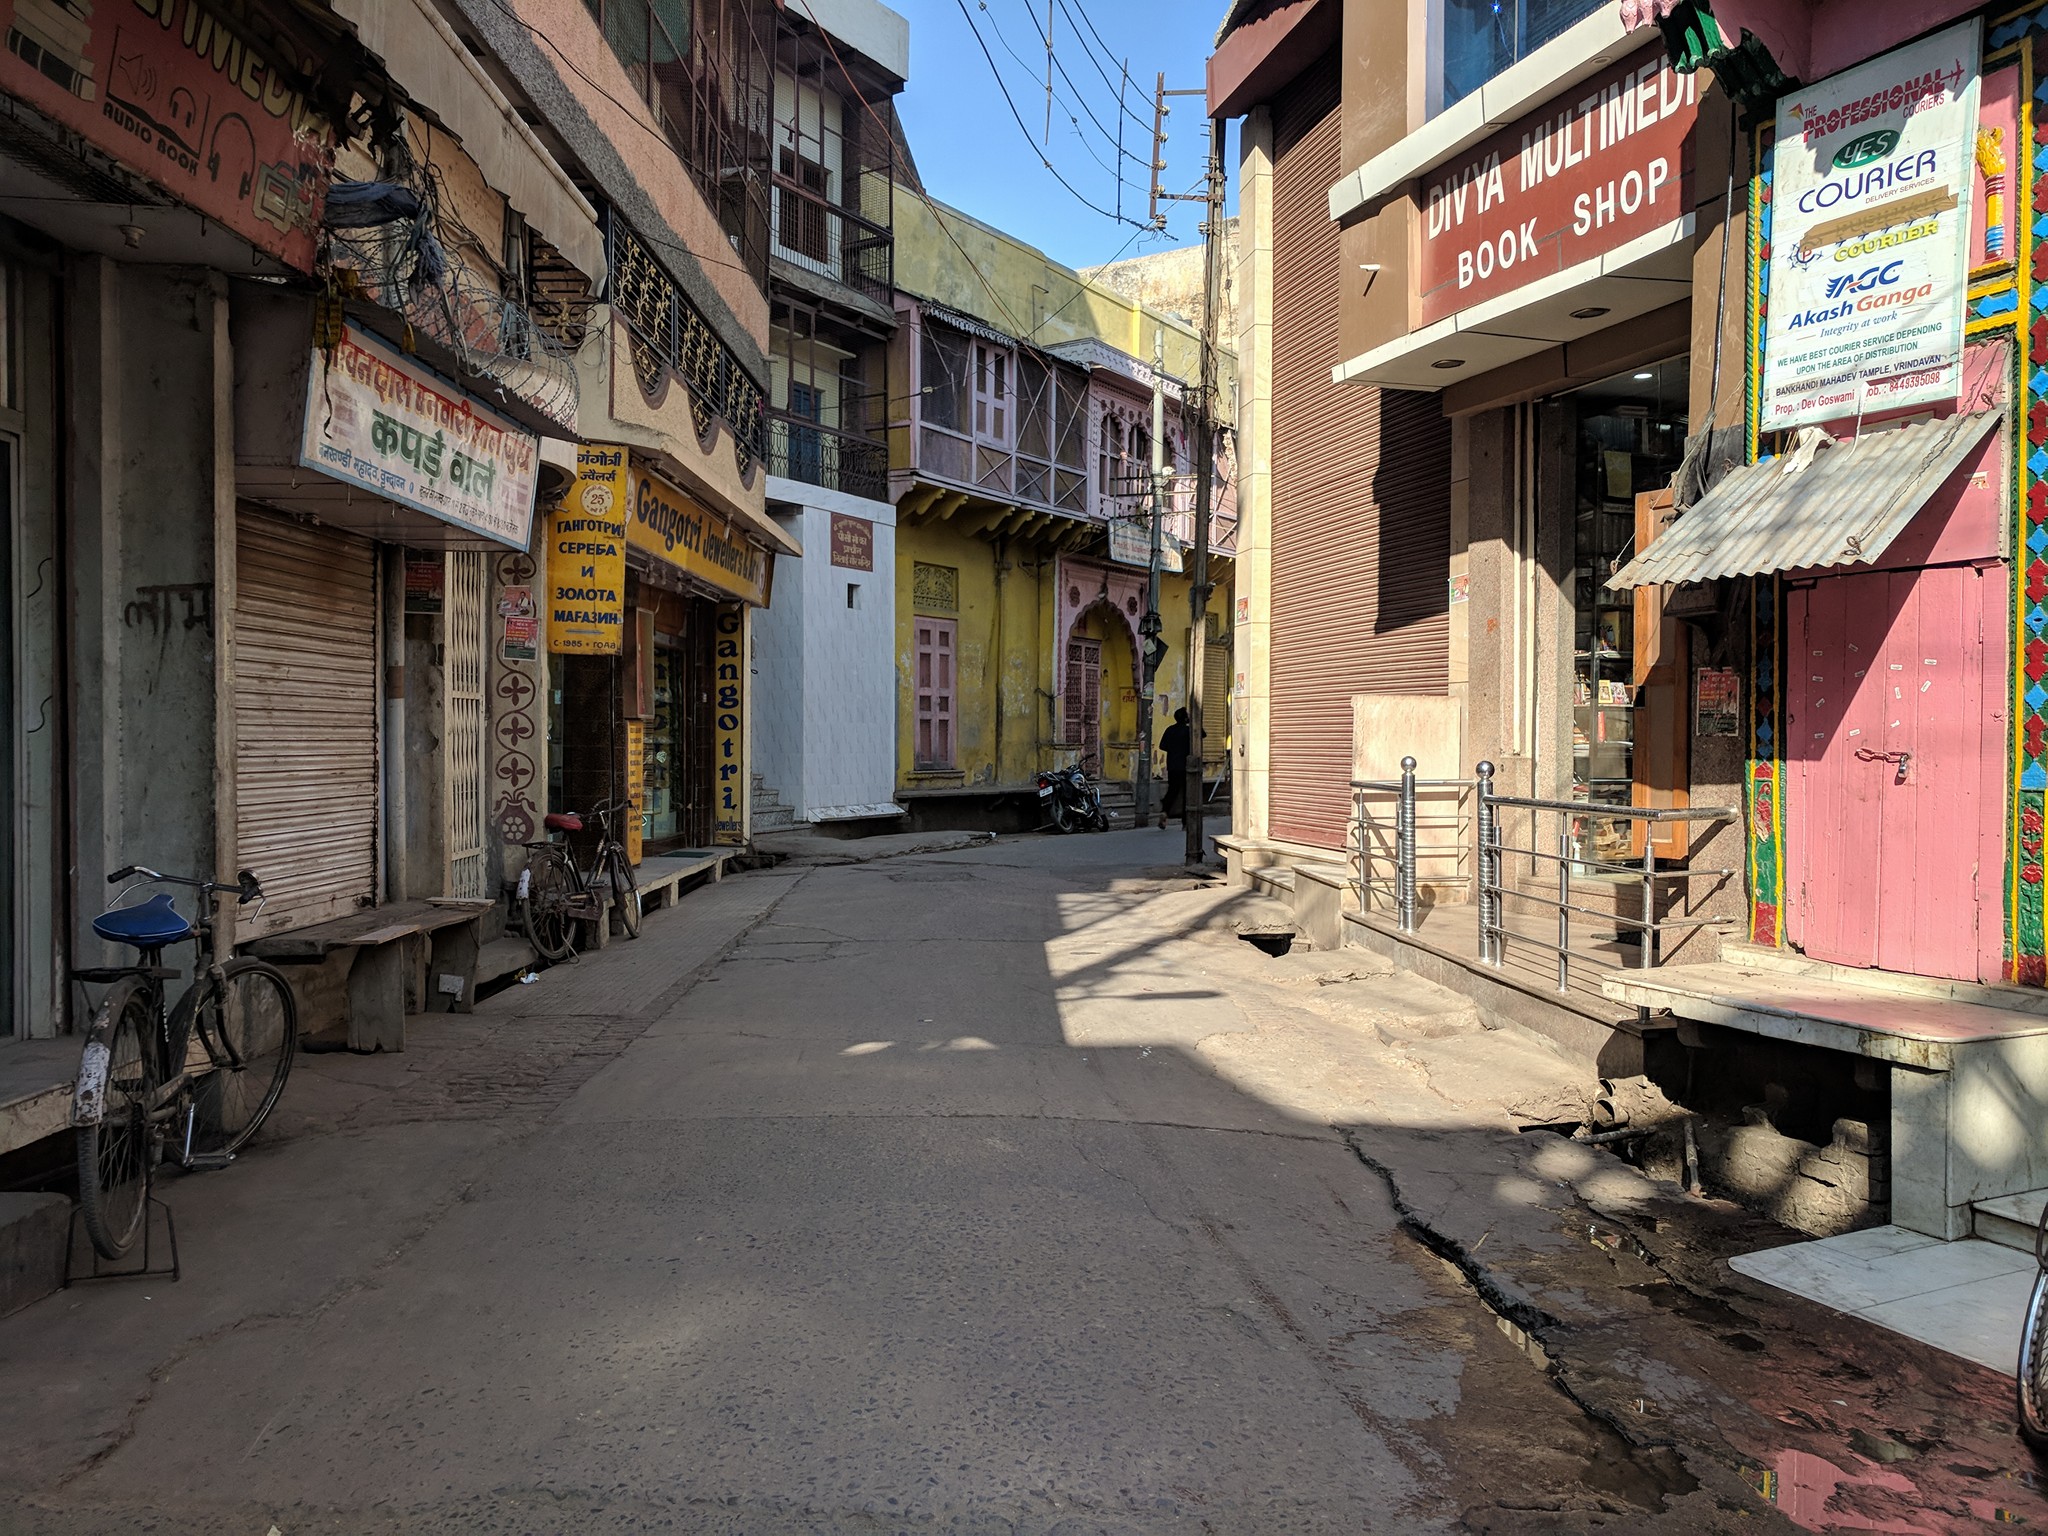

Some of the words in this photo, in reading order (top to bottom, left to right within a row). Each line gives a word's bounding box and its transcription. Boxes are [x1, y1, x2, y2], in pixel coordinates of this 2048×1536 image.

[1802, 68, 1946, 143] PROFESSIONAL
[1804, 104, 1818, 119] THE
[1902, 92, 1945, 119] COURIERS
[102, 100, 153, 145] AUDIO
[156, 136, 199, 177] BOOK
[1428, 150, 1506, 240] DIVYA
[1520, 53, 1695, 193] MULTIMEDI
[1798, 149, 1936, 214] COURIER
[1865, 188, 1898, 204] DELIVERY
[1899, 176, 1935, 193] SERVICES
[1458, 216, 1539, 290] BOOK
[1572, 157, 1669, 237] SHOP
[1834, 220, 1939, 262] COURIER
[1825, 260, 1904, 299] AGC
[1788, 300, 1853, 330] Akash
[1856, 283, 1933, 312] Ganga
[1820, 322, 1860, 338] Integrity
[1860, 317, 1872, 328] at
[1872, 310, 1898, 325] work
[1777, 358, 1789, 368] WE
[1789, 354, 1808, 366] HAVE
[1809, 349, 1828, 361] BEST
[1828, 342, 1861, 357] COURIER
[1862, 334, 1895, 348] SERVICE
[1896, 322, 1943, 341] DEPENDING
[1796, 364, 1816, 375] UPON
[1817, 360, 1831, 371] THE
[1832, 356, 1853, 368] AREA
[1853, 353, 1865, 363] OF
[1865, 341, 1919, 361] DISTRIBUTION
[1775, 401, 1795, 416] Prop.
[1801, 396, 1818, 410] Dev
[1818, 388, 1855, 406] Goswami
[1889, 371, 1941, 394] 8449395098
[1776, 380, 1819, 397] BANKHANDI
[1819, 373, 1857, 386] MAHADEV
[1858, 364, 1892, 379] TAMPLE,
[1894, 354, 1941, 372] VRINDAVAN
[450, 450, 496, 503] वाले
[577, 450, 622, 467] गंगोत्री
[590, 493, 605, 506] 25
[636, 478, 702, 553] Gangotri
[702, 520, 743, 577] Jewellers
[716, 612, 742, 811] Gangotri
[714, 815, 743, 832] Jewellers
